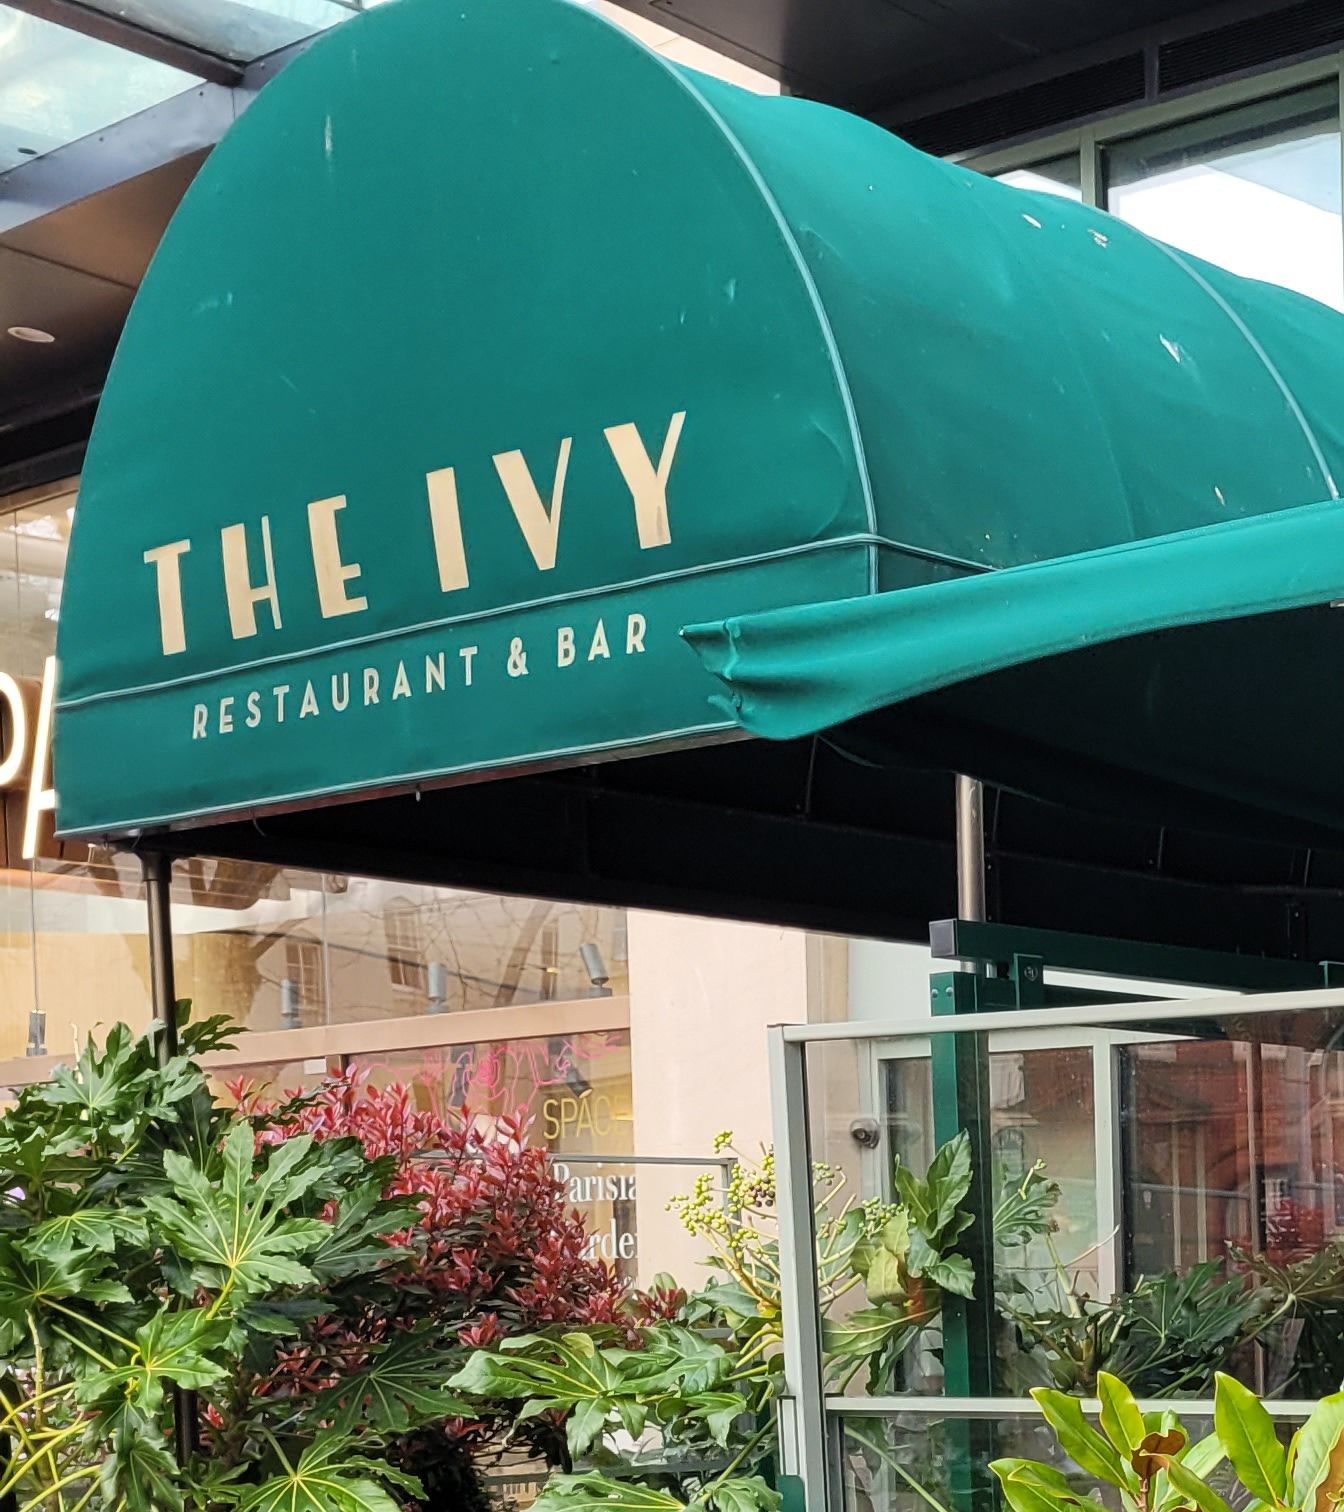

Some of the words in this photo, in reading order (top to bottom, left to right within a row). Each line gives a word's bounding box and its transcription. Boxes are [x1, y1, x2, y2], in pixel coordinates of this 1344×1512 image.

[144, 495, 368, 656] THE
[426, 411, 686, 592] IVY
[192, 646, 478, 740] RESTAURANT
[506, 636, 529, 677] &
[557, 613, 647, 667] BAR
